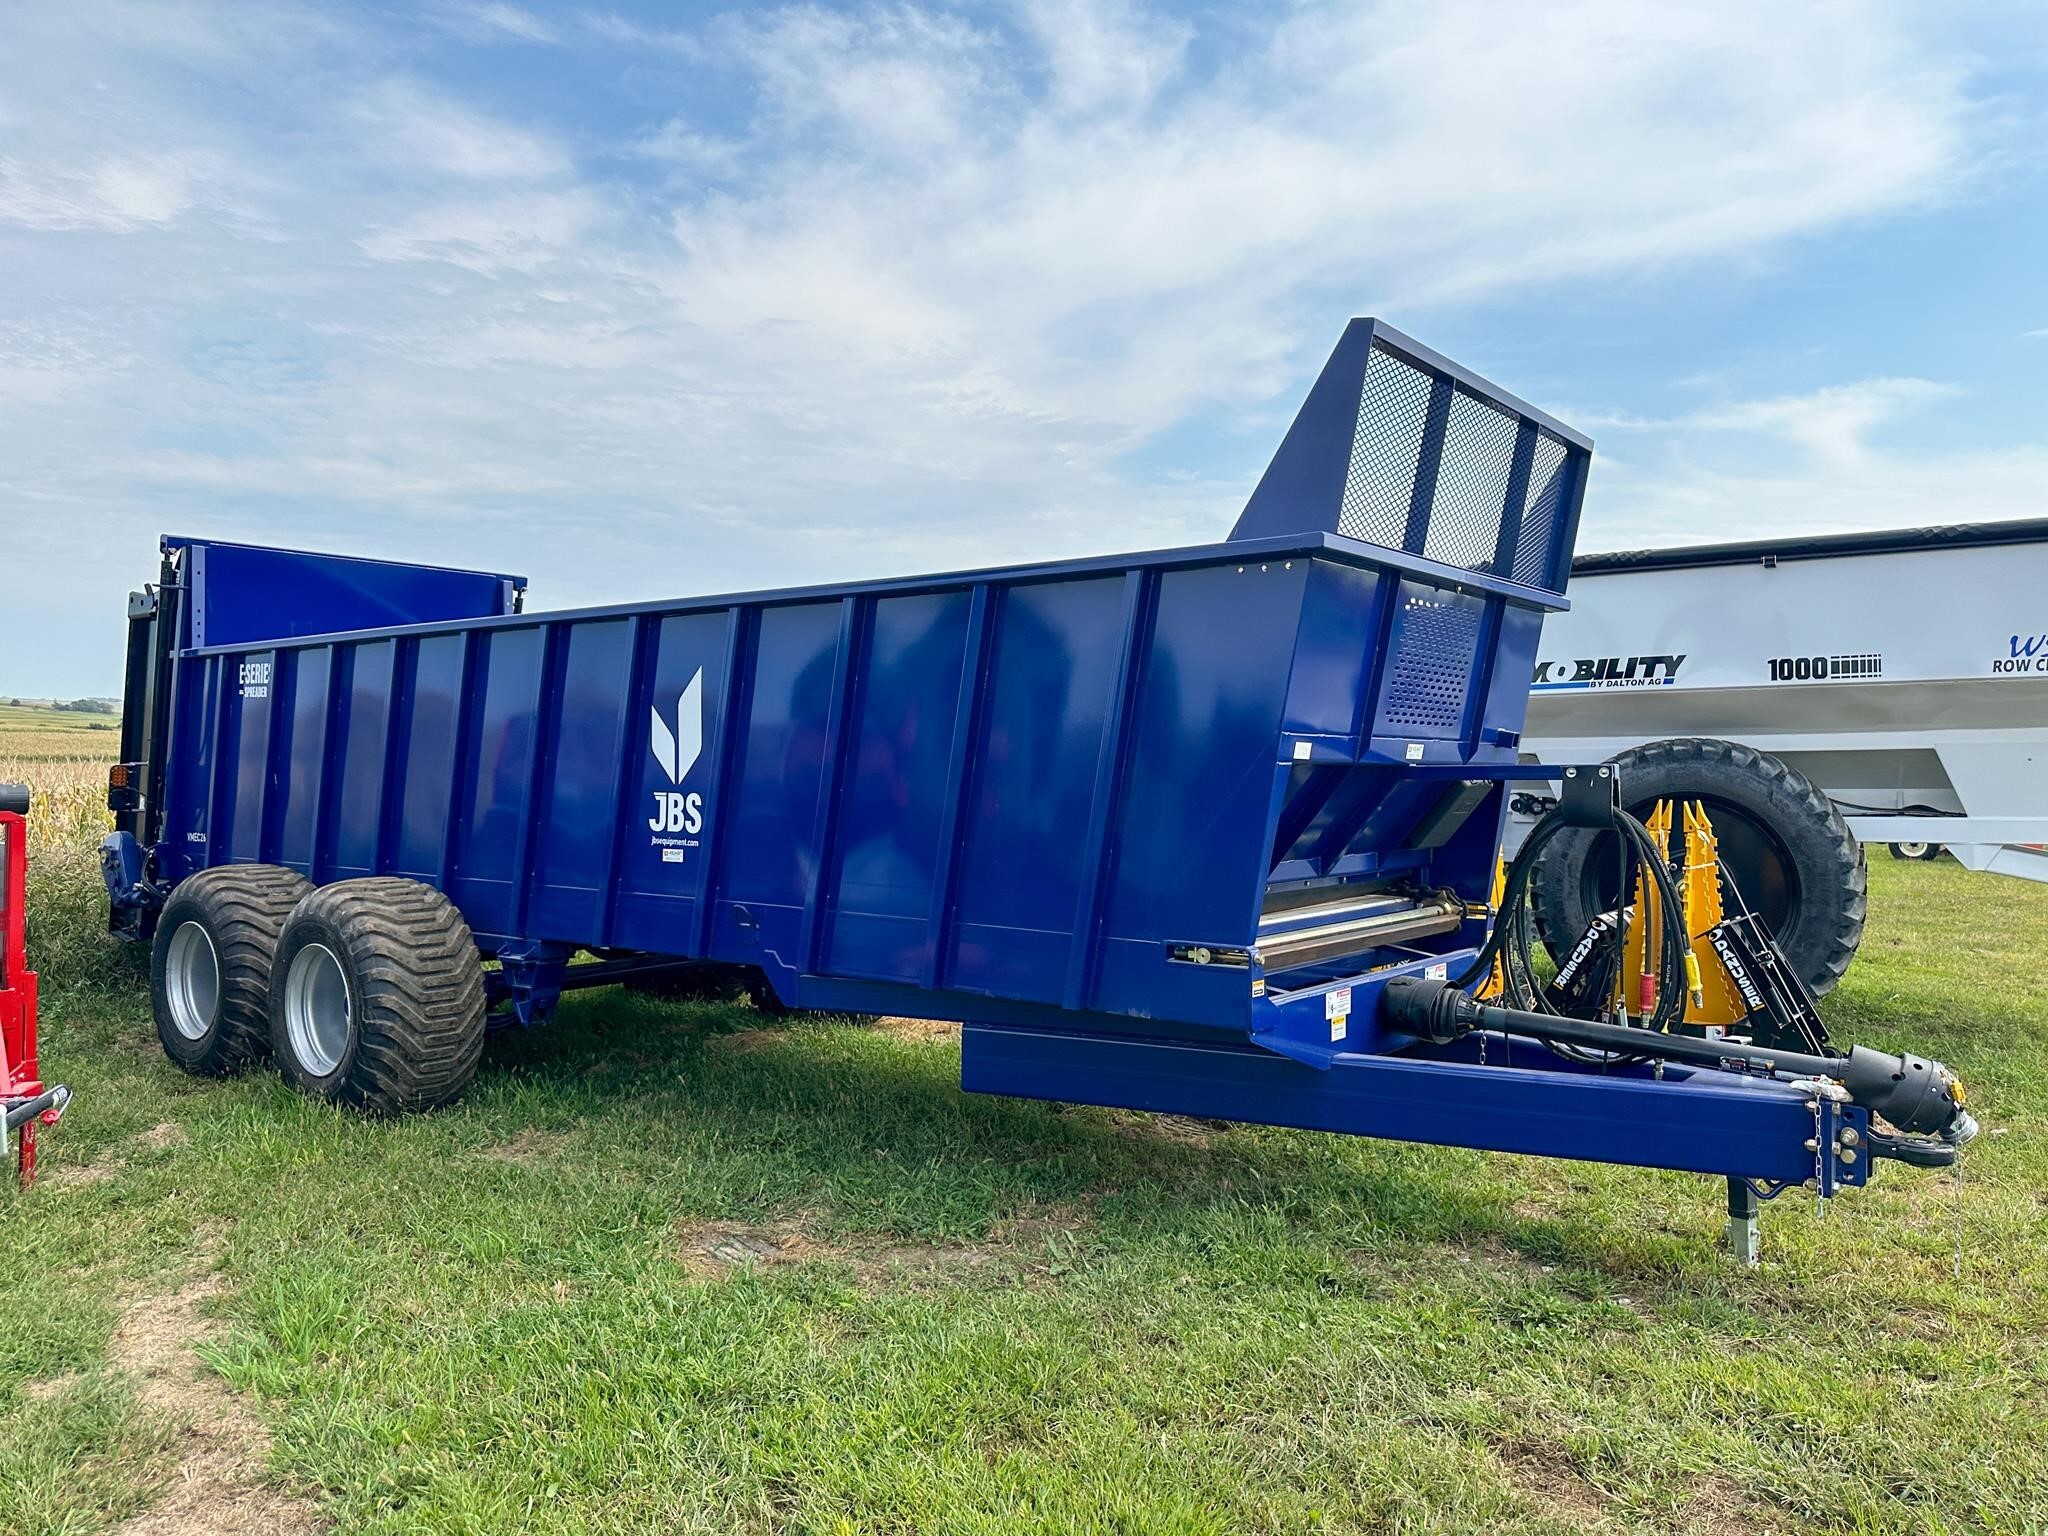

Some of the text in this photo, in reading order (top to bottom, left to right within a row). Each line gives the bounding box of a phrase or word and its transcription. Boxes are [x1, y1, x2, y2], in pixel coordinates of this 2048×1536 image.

[1532, 654, 1687, 683] MOBILITY
[1767, 656, 1828, 681] 1000
[1992, 658, 2048, 673] ROW C
[244, 686, 268, 698] SPREADER
[1606, 679, 1645, 688] DALTON
[1648, 678, 1662, 686] AG
[649, 792, 702, 834] JBS
[650, 836, 699, 847] jbsequipment.com
[1554, 927, 1600, 987] DANUSER
[1714, 939, 1764, 1008] DANUSER
